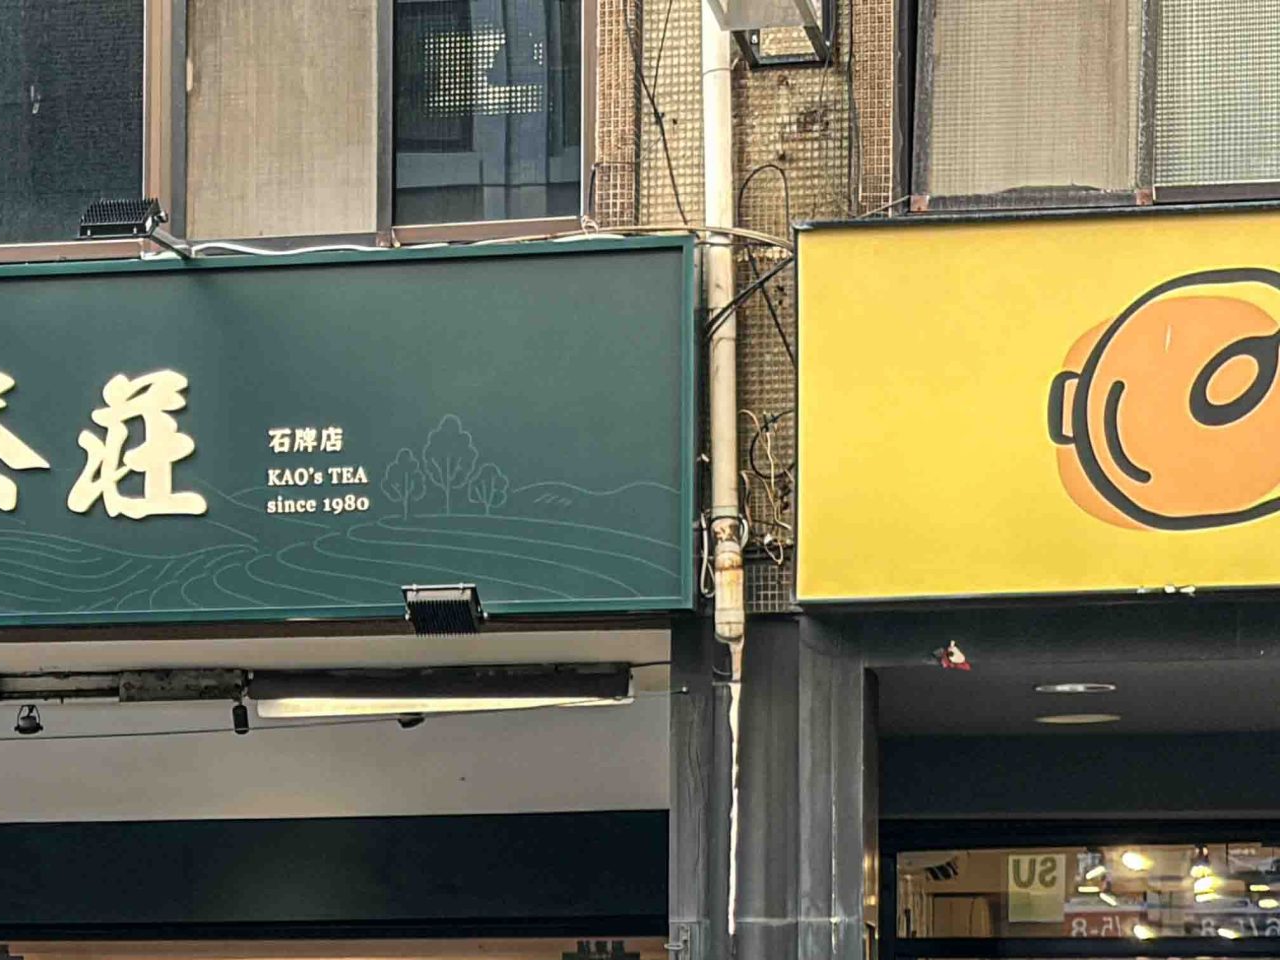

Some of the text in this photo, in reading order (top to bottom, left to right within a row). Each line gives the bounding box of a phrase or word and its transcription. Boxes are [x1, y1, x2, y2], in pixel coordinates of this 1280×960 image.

[268, 427, 344, 453] 石牌店
[267, 466, 369, 486] KAO's TEA
[267, 494, 370, 514] since 1980
